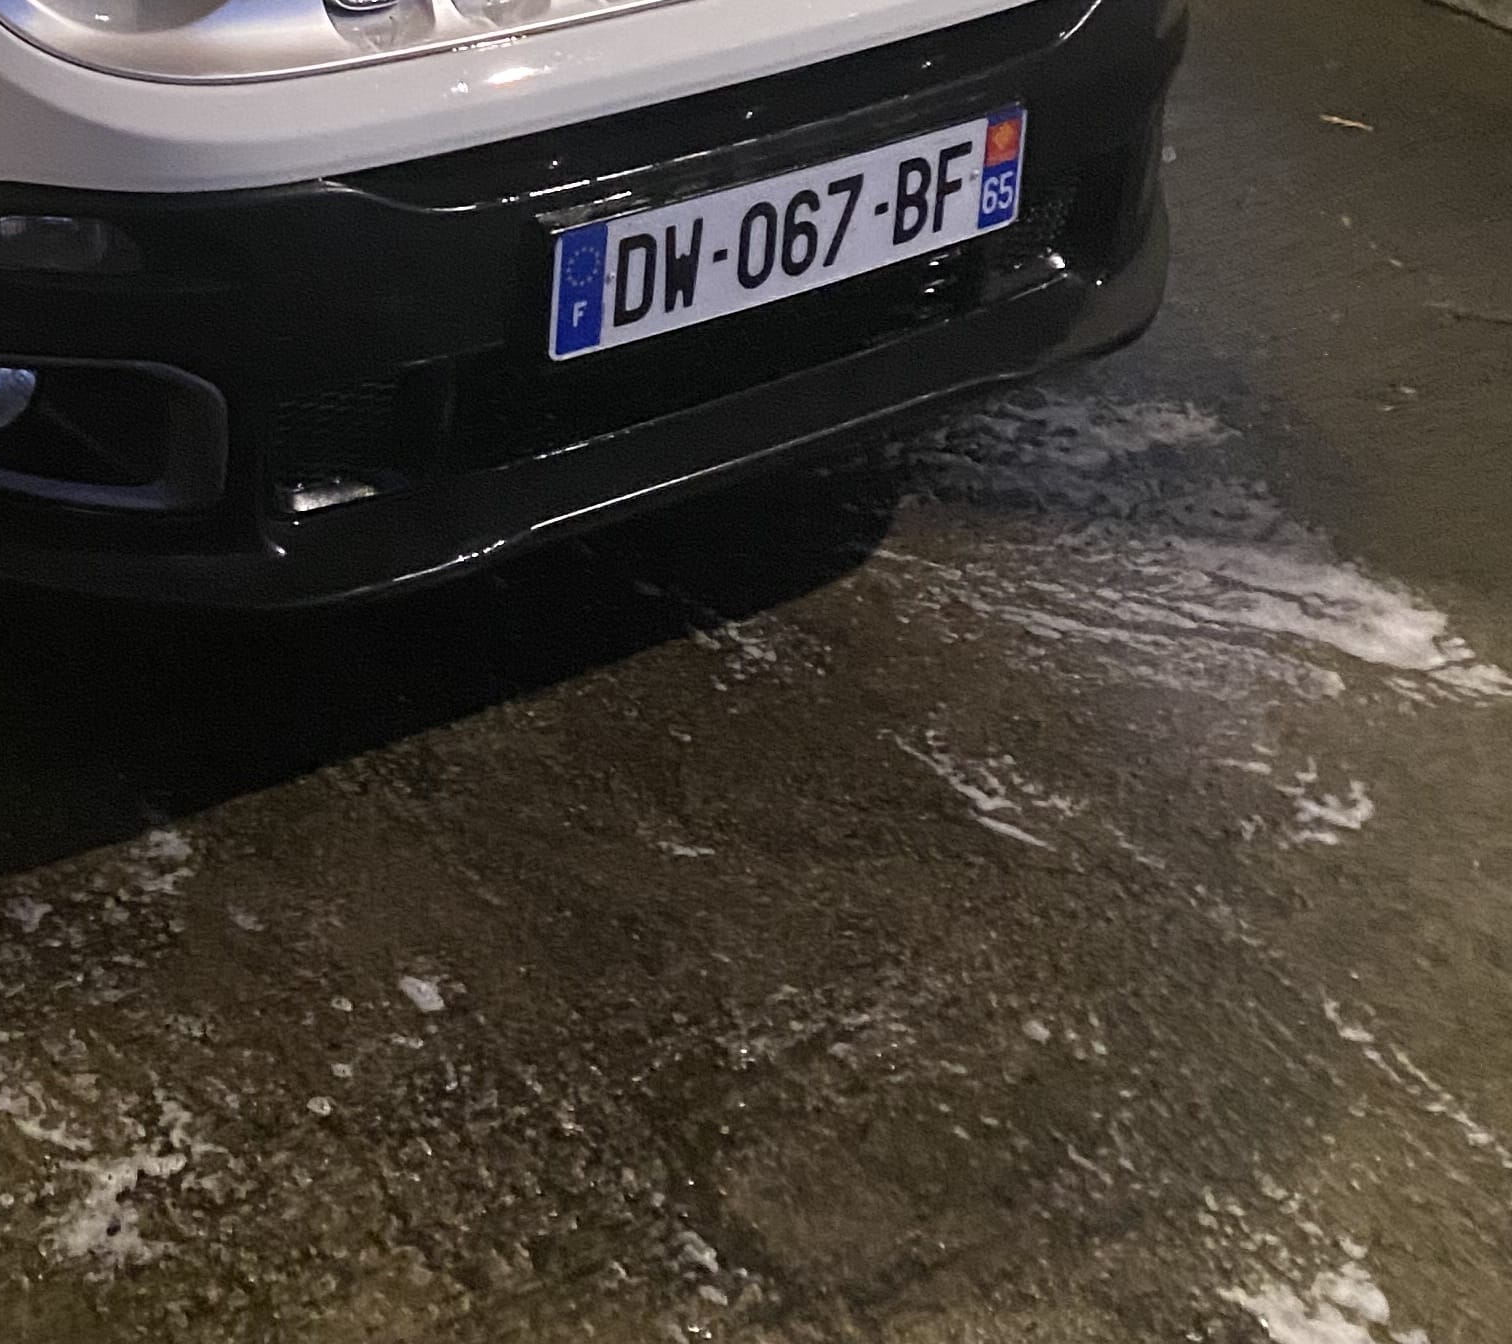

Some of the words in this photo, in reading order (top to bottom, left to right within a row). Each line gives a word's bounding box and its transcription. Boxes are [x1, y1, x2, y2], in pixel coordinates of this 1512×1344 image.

[982, 172, 1014, 215] 65
[613, 141, 973, 327] DW-067-BF
[572, 301, 587, 328] F
